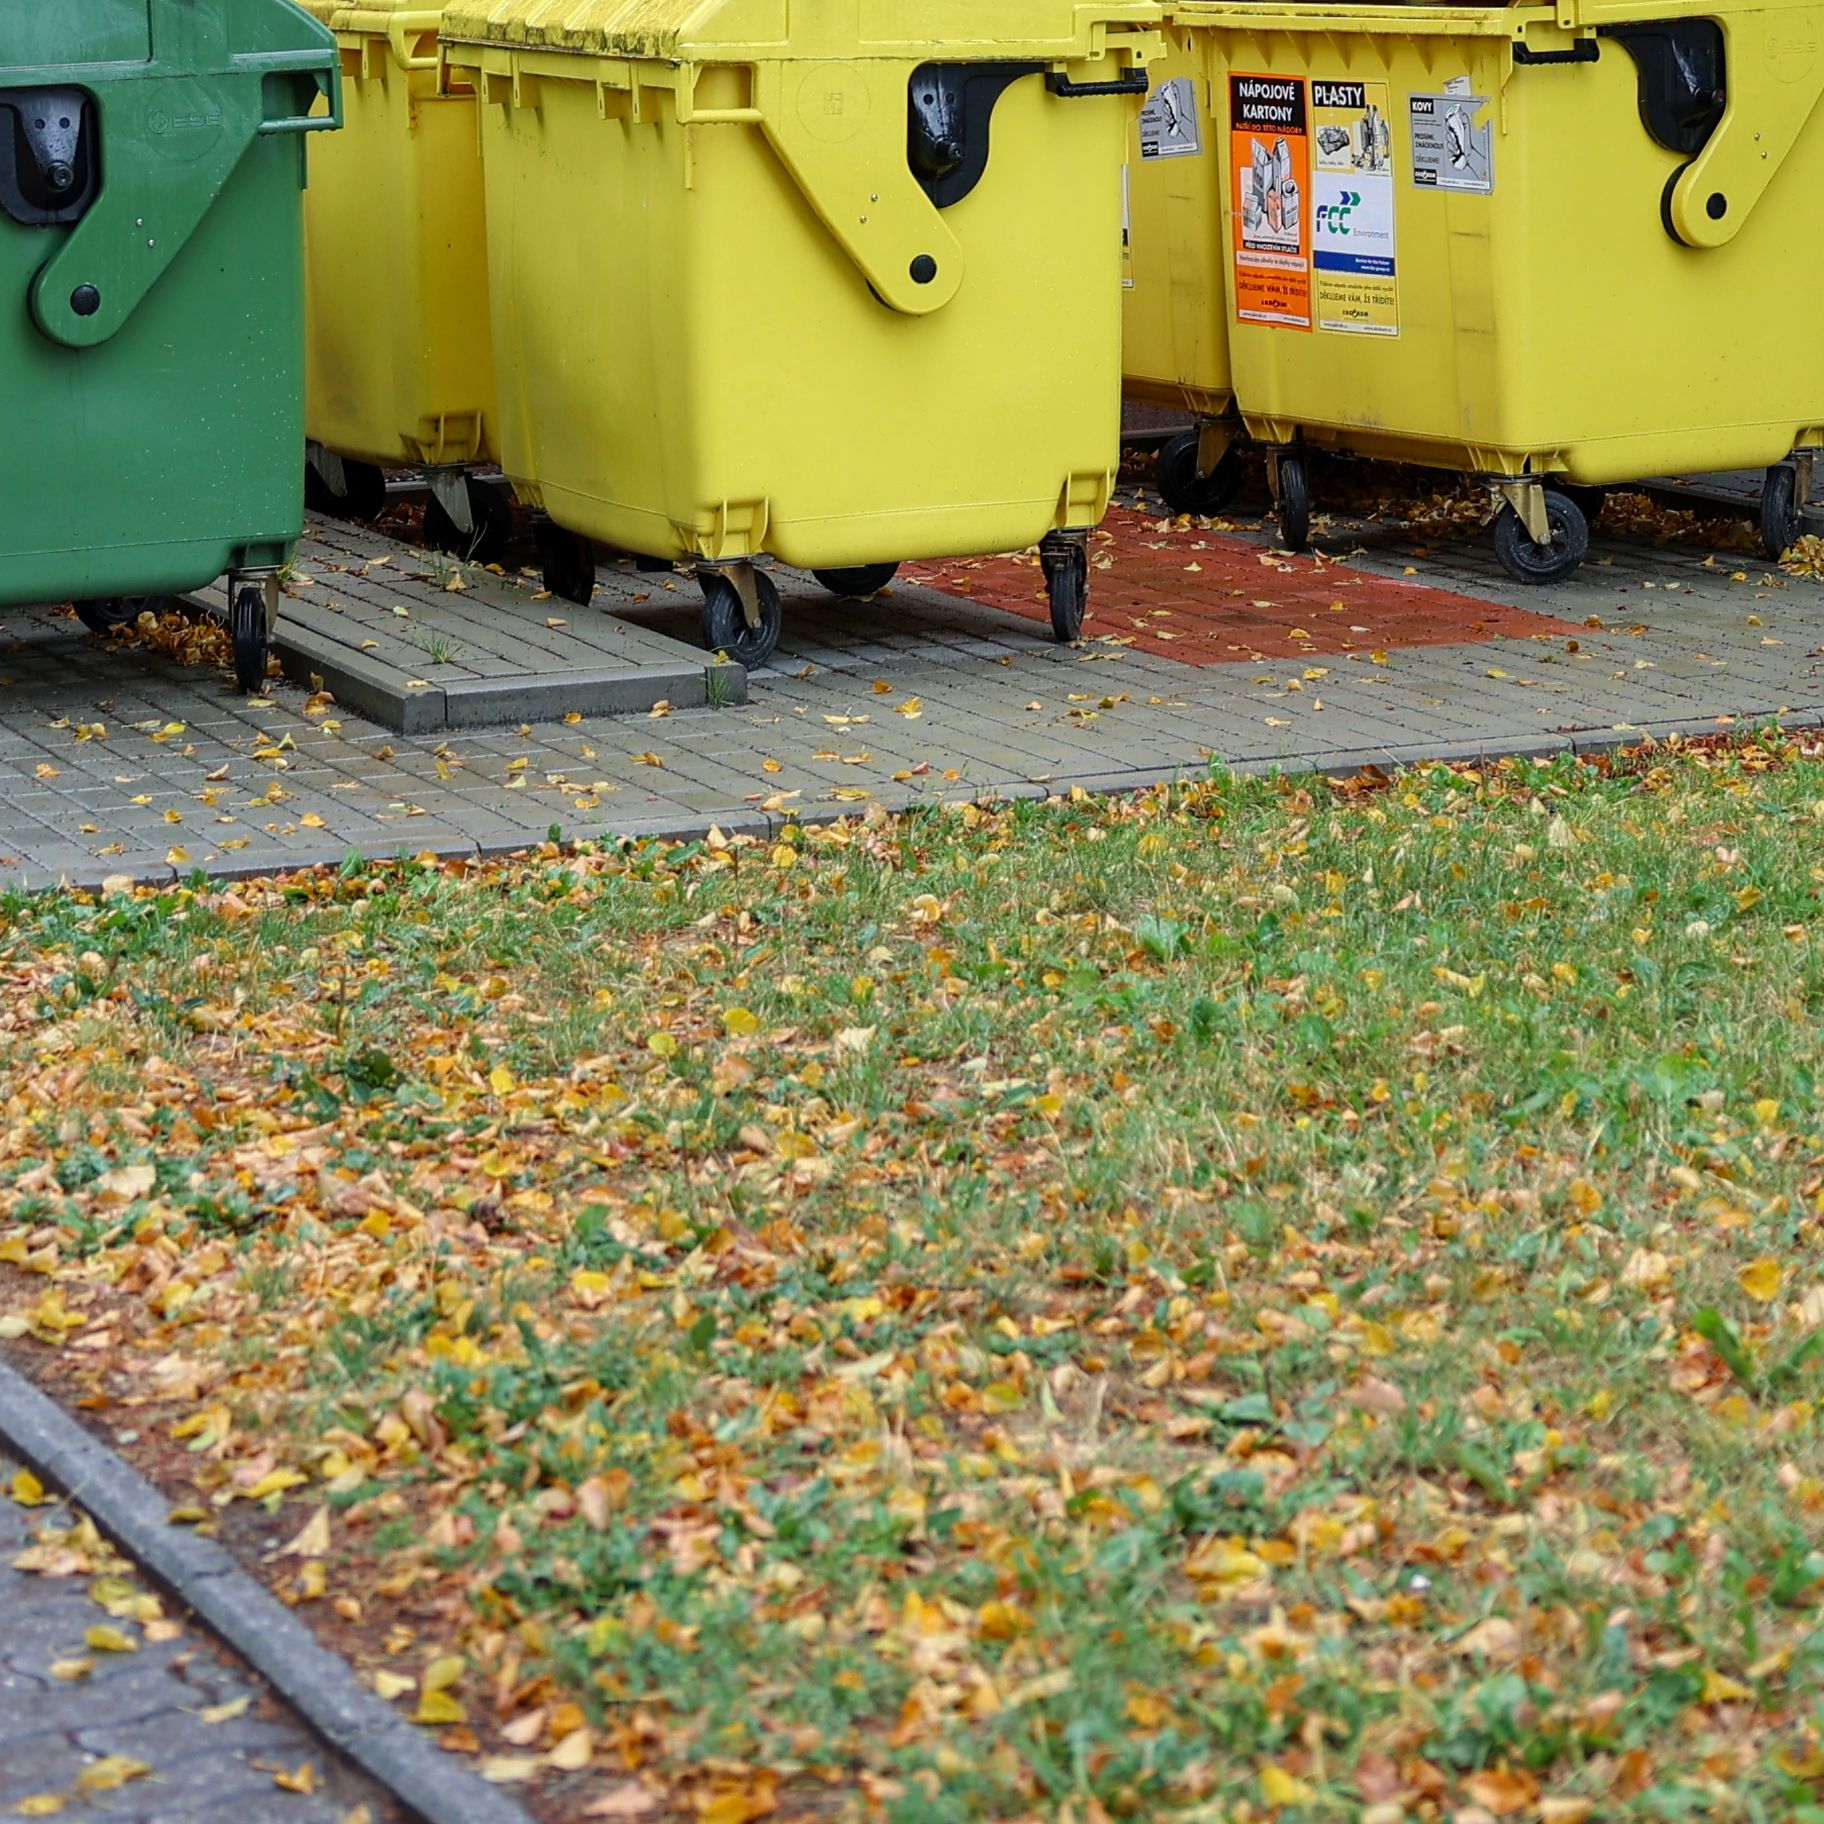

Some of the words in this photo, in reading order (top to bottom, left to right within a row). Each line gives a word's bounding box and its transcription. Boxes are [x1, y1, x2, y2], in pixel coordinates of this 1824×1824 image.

[1238, 79, 1296, 101] NÁPOJOVÉ
[1314, 85, 1363, 106] PLASTY
[1242, 103, 1293, 121] KARTONY
[1411, 101, 1433, 112] KOVY
[1316, 204, 1351, 235] FCC
[1353, 228, 1390, 239] Environment
